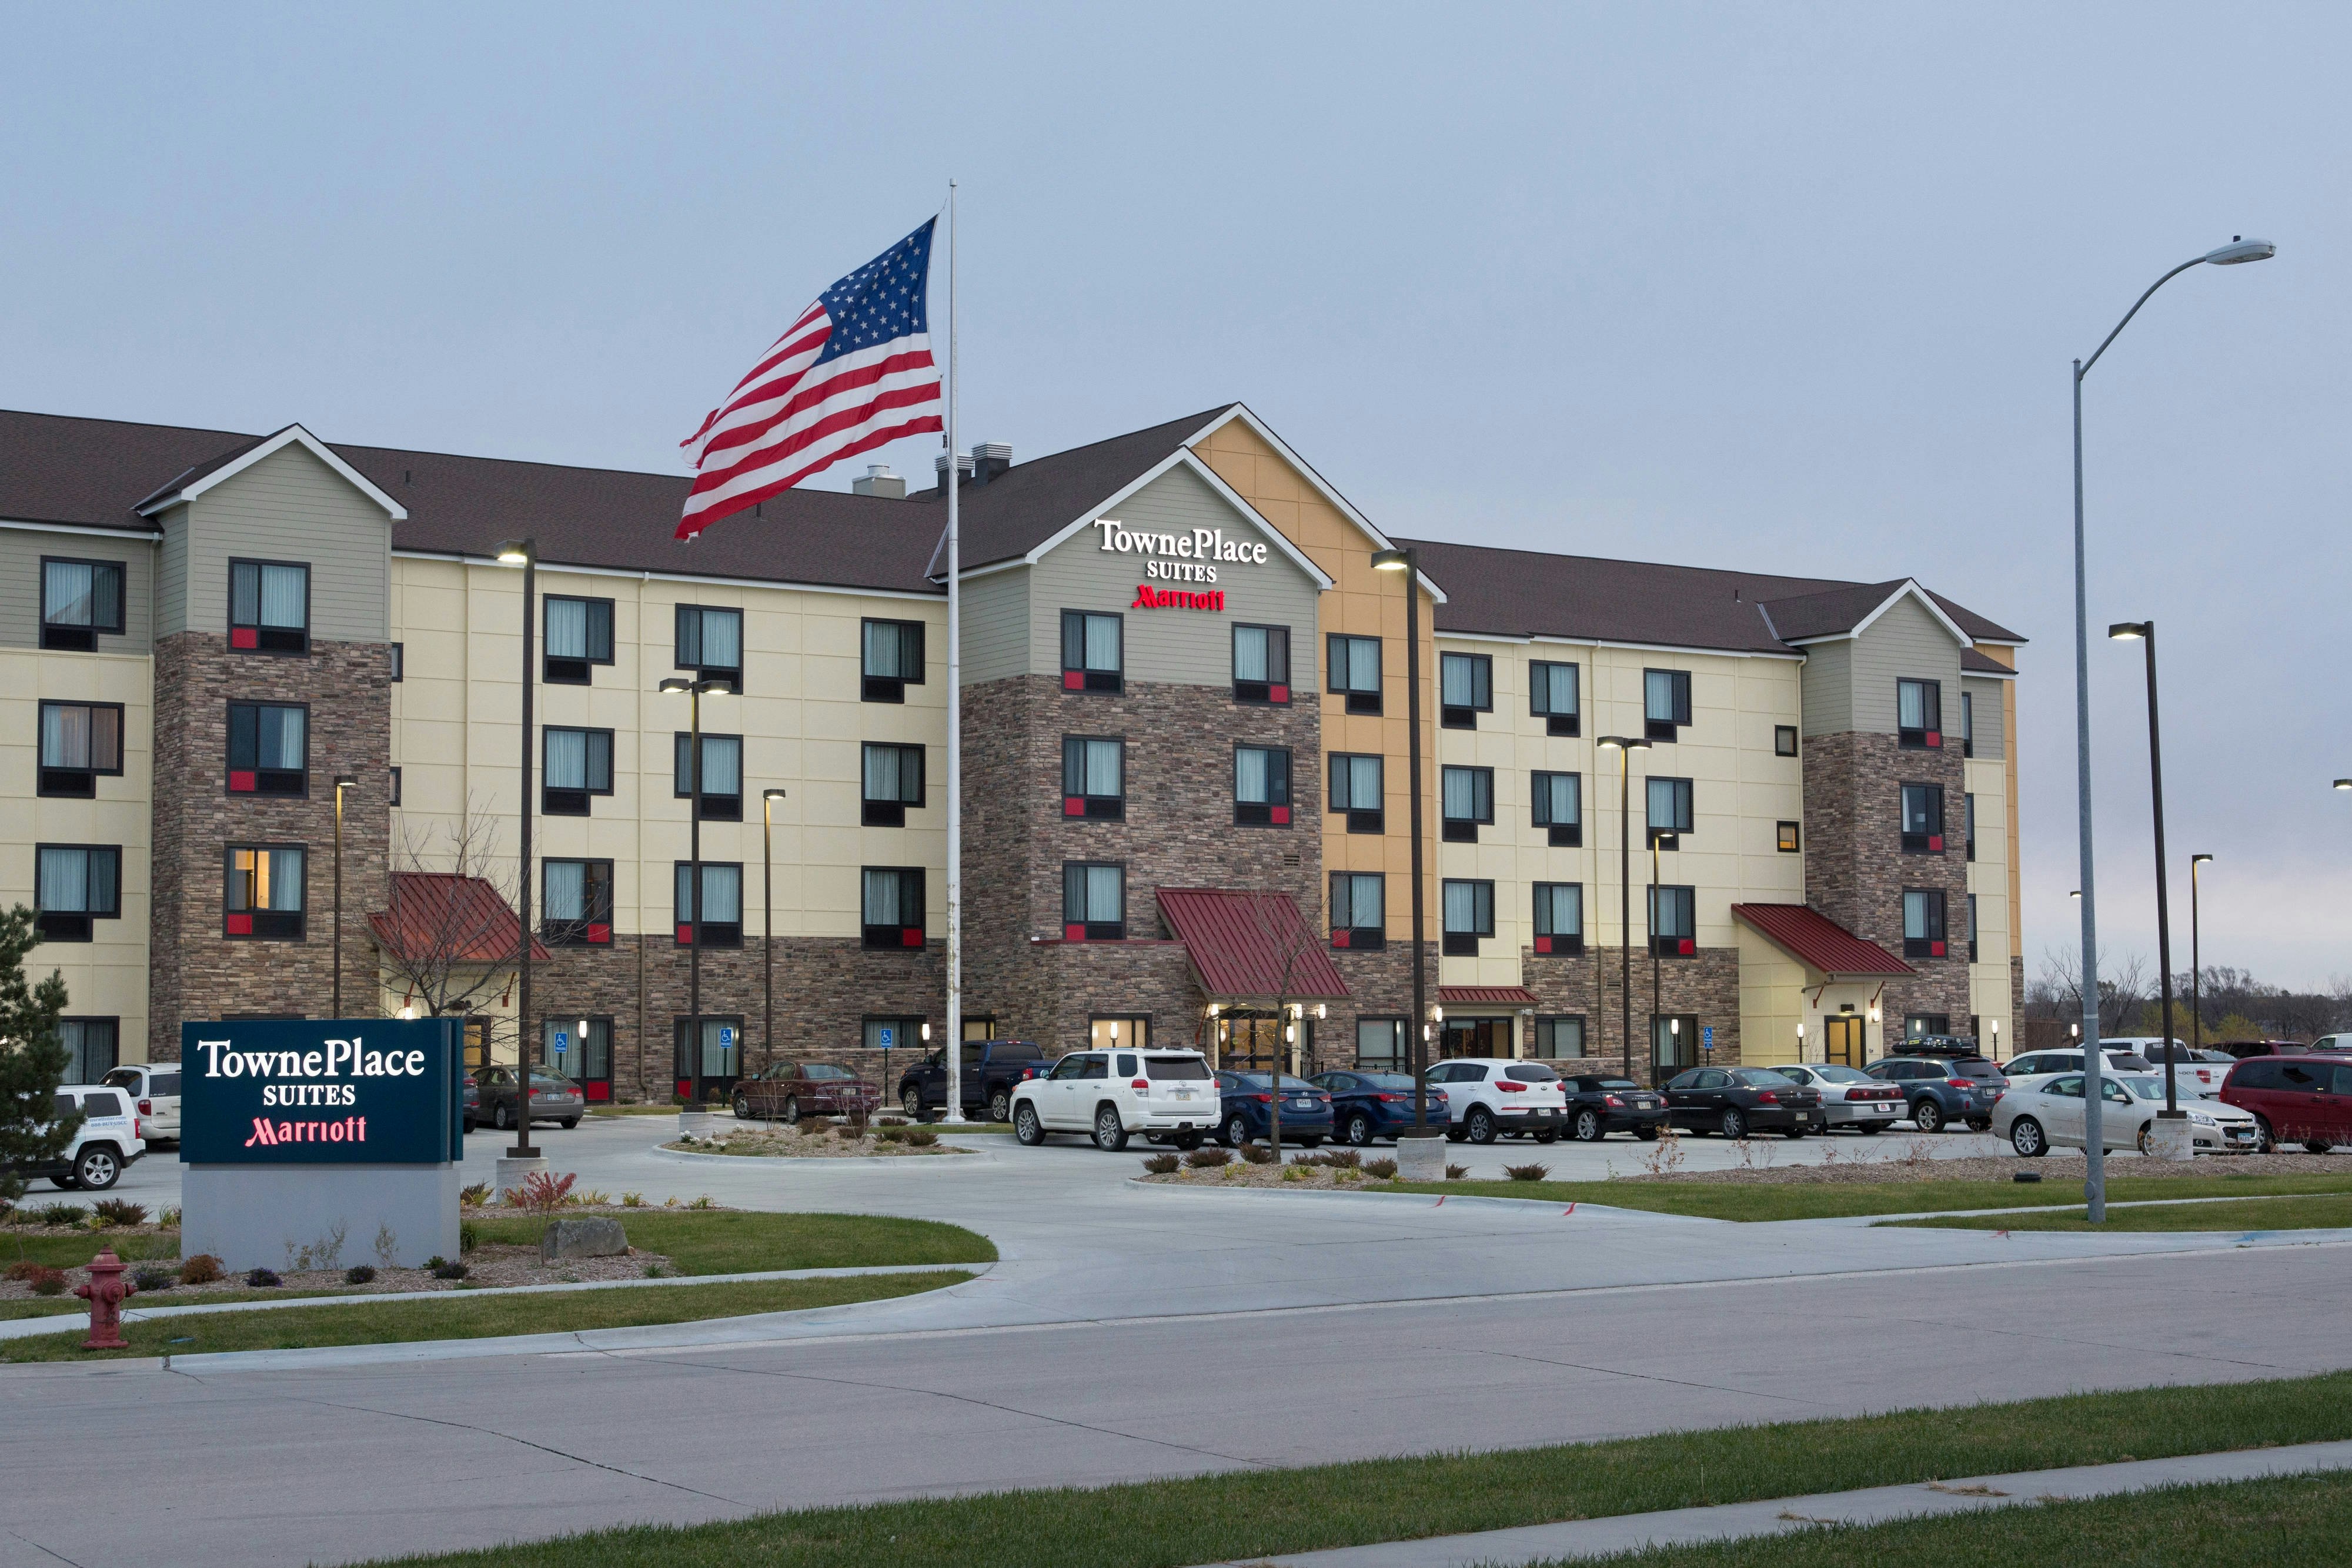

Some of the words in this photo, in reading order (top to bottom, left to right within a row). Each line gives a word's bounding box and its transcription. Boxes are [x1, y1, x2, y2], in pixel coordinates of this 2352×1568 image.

[1094, 518, 1267, 564] TownePlace
[1147, 560, 1217, 583] SUITES
[1131, 583, 1225, 611] Marriott
[197, 1037, 425, 1078] TownePlace
[263, 1084, 356, 1106] SUITES
[245, 1116, 366, 1148] Marriott
